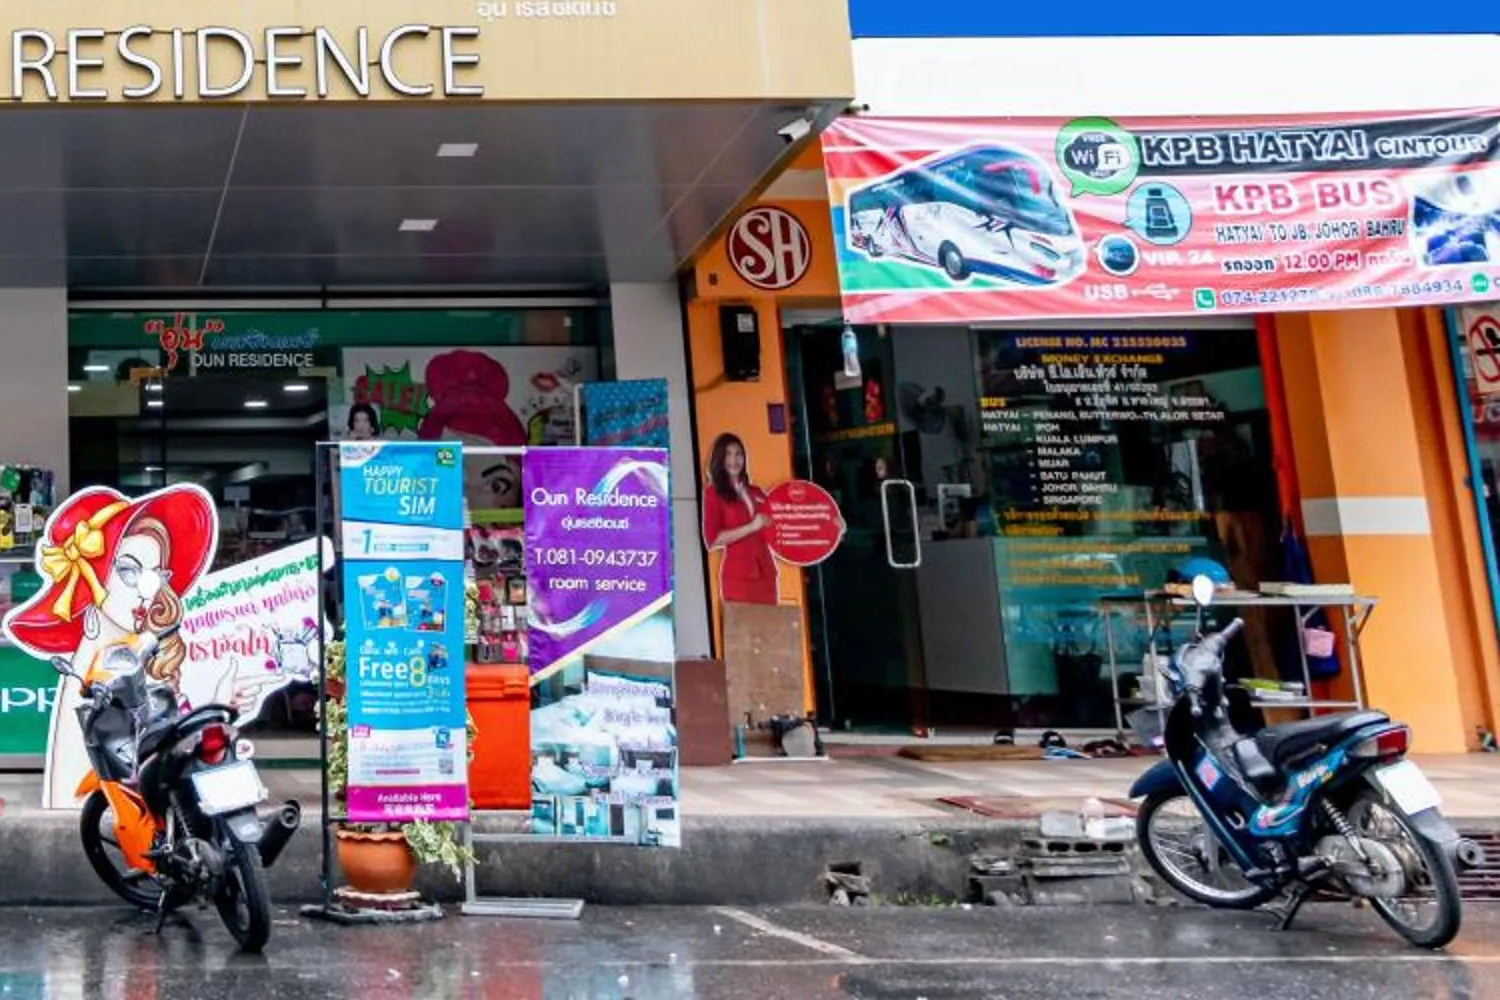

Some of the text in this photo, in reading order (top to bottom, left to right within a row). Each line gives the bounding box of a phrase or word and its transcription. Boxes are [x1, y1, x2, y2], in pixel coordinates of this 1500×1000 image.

[11, 27, 485, 101] RESIDENCE
[1142, 136, 1223, 165] KPB
[1229, 130, 1369, 162] HATYAI
[1214, 179, 1396, 211] KPB BUS
[1215, 224, 1264, 242] HATYAI
[1269, 223, 1287, 240] TO
[1315, 220, 1360, 239] JOHOR
[1367, 218, 1405, 238] BAHRU
[739, 210, 804, 285] SH
[1334, 252, 1360, 267] PM
[1084, 284, 1129, 300] USB
[228, 353, 314, 368] RESIDENCE
[1040, 353, 1164, 364] MONEY EXCHANGE
[980, 397, 1007, 408] BUS
[981, 410, 1020, 420] HATYAI
[1035, 434, 1118, 444] KUALA LUMPUR
[1036, 447, 1082, 457] MALAKA
[362, 465, 403, 478] HAPPY
[364, 477, 438, 496] TOURIST
[1040, 483, 1078, 494] JOHOR
[531, 487, 658, 507] Oun Residence
[1042, 495, 1103, 505] SINGAPORE
[397, 495, 437, 517] SIM
[549, 576, 647, 591] room service
[359, 656, 408, 680] Free
[410, 655, 427, 688] 8
